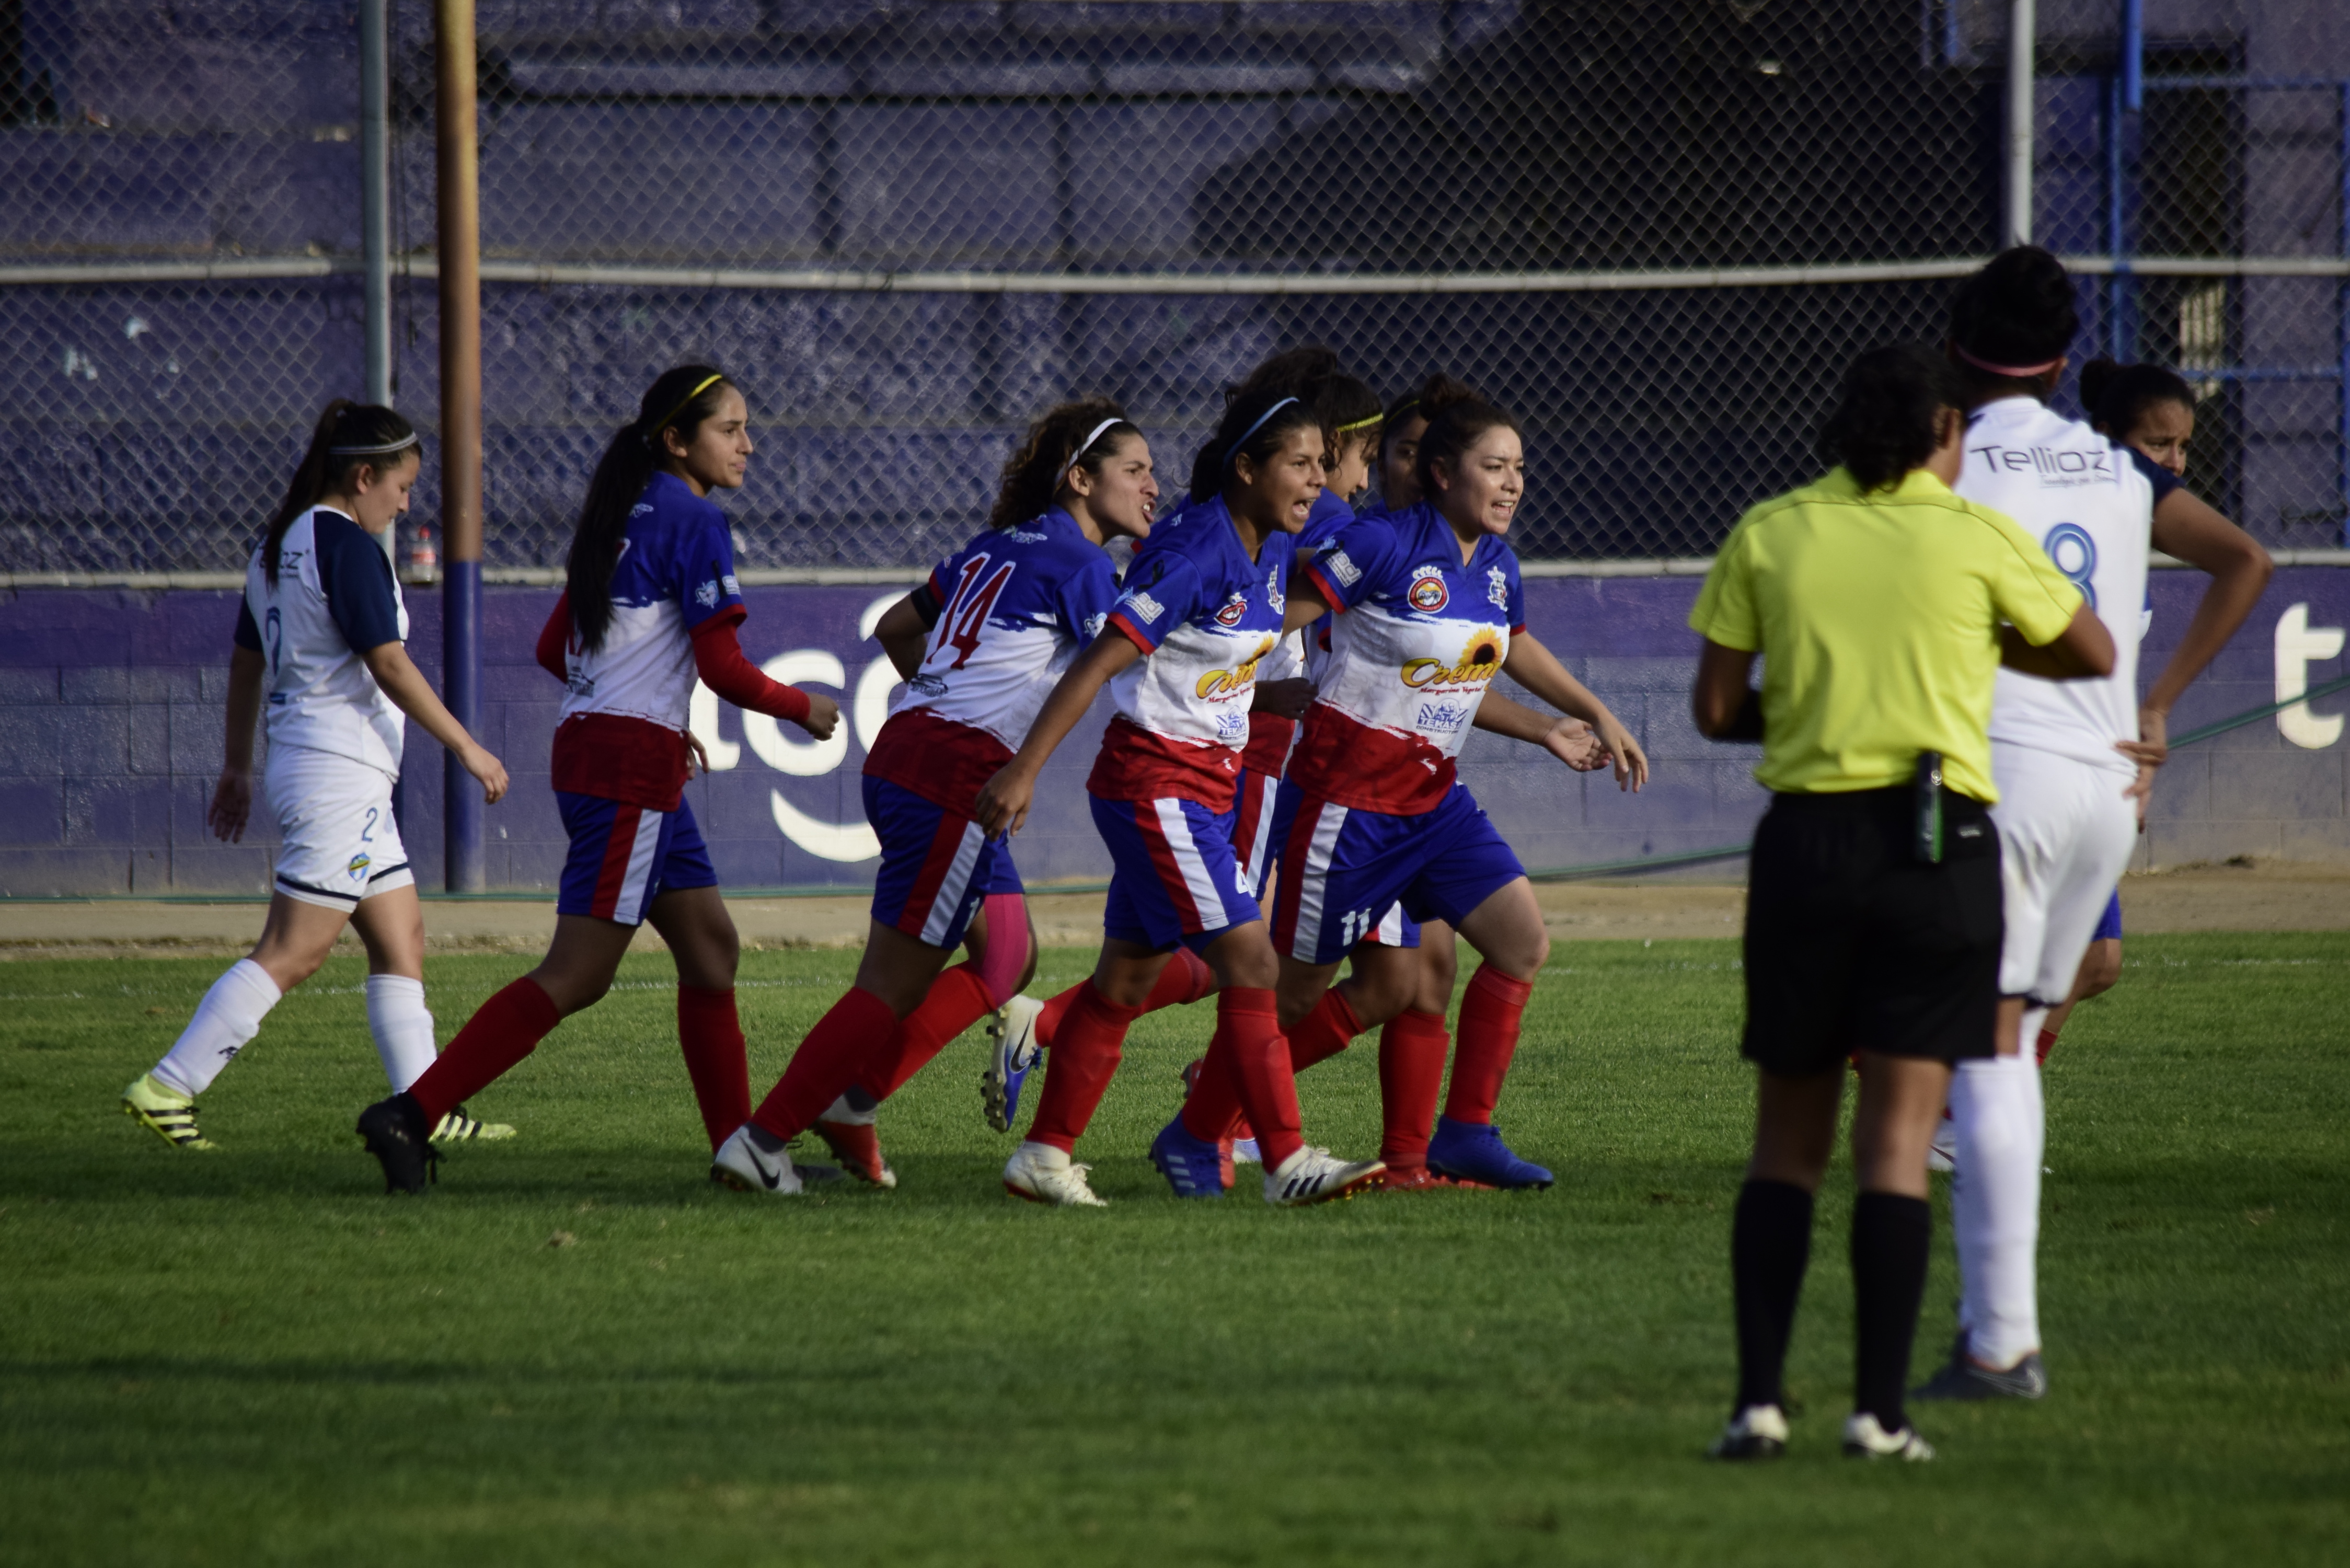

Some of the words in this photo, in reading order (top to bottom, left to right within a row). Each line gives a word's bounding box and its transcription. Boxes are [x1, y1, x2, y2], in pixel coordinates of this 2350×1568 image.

[1969, 445, 2112, 473] Tellioz
[2043, 522, 2098, 614] 8
[926, 551, 1016, 671] 14
[362, 806, 377, 842] 2
[1234, 862, 1255, 898] 4
[1341, 908, 1372, 947] 11
